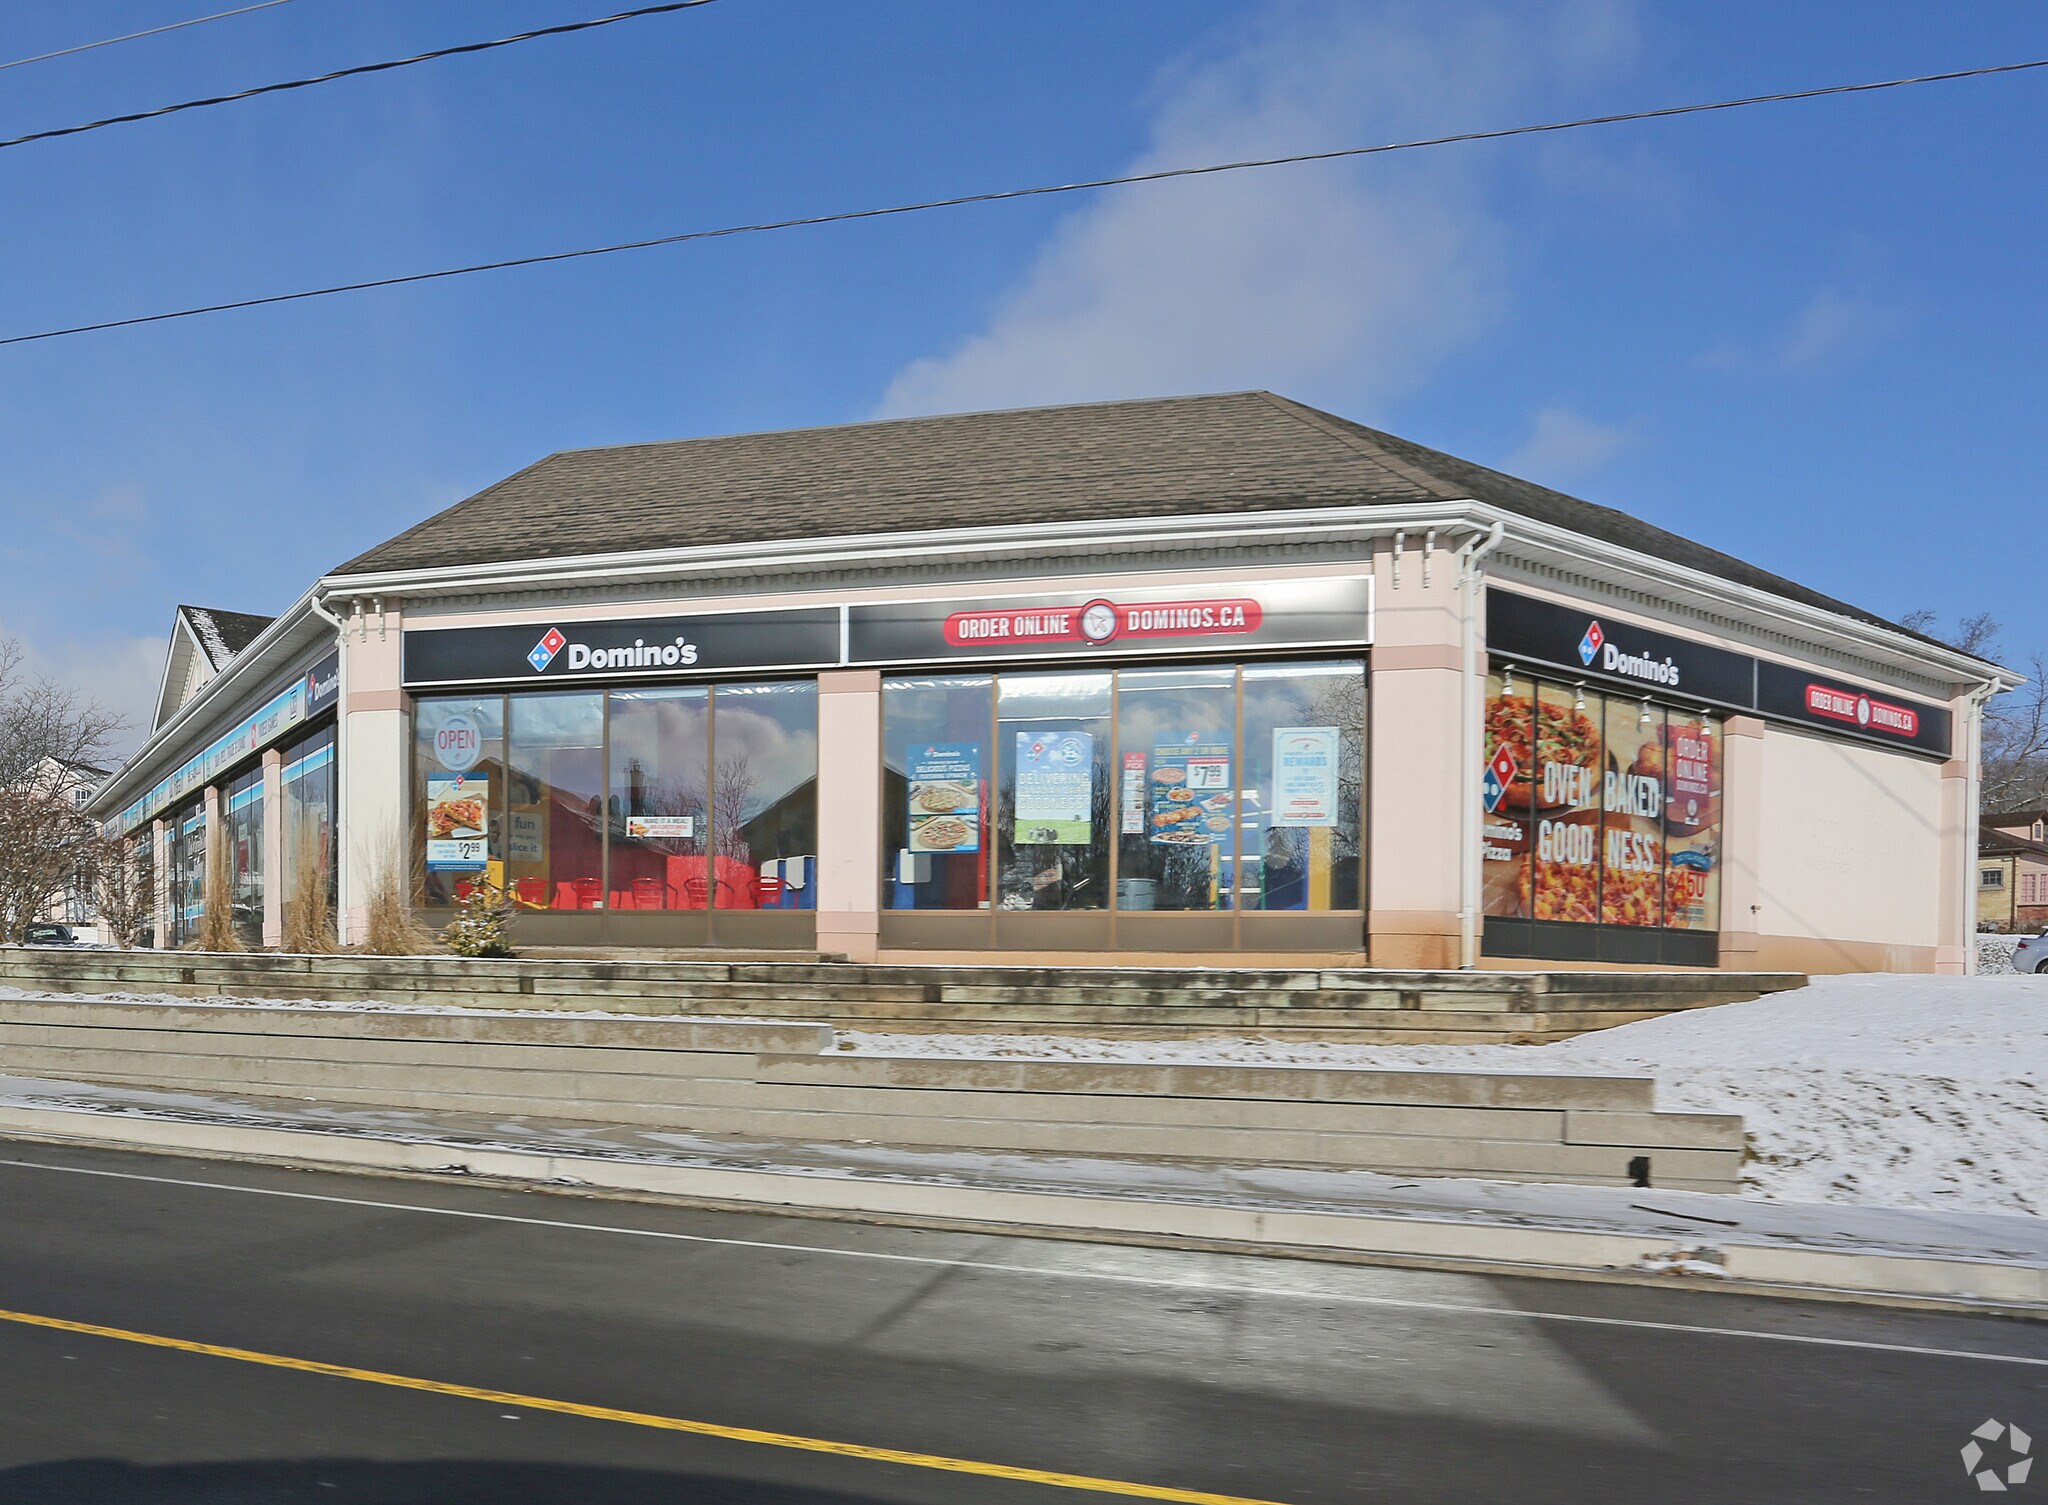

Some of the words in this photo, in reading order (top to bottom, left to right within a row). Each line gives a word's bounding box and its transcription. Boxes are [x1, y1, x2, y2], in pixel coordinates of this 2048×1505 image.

[958, 616, 1010, 639] ORDER
[1013, 613, 1071, 637] ONLINE
[1127, 606, 1246, 632] DOMINOS.CA
[568, 636, 698, 670] Domino's
[1603, 642, 1680, 686] Domino's
[315, 667, 339, 701] Domino'
[1810, 690, 1832, 711] ORDER
[1832, 696, 1854, 717] ONLINE
[1872, 706, 1913, 731] DOMINOS.CA
[438, 730, 475, 750] OPEN
[1677, 737, 1709, 761] ORDER
[1019, 772, 1089, 785] DELIVERING
[1677, 759, 1709, 782] ONLINE
[1544, 761, 1592, 808] OVEN
[1604, 770, 1660, 818] BAKED
[514, 816, 536, 831] fun
[1482, 820, 1523, 841] mino's
[530, 841, 538, 853] it
[1539, 819, 1594, 865] GOOD
[1607, 829, 1656, 872] NESS
